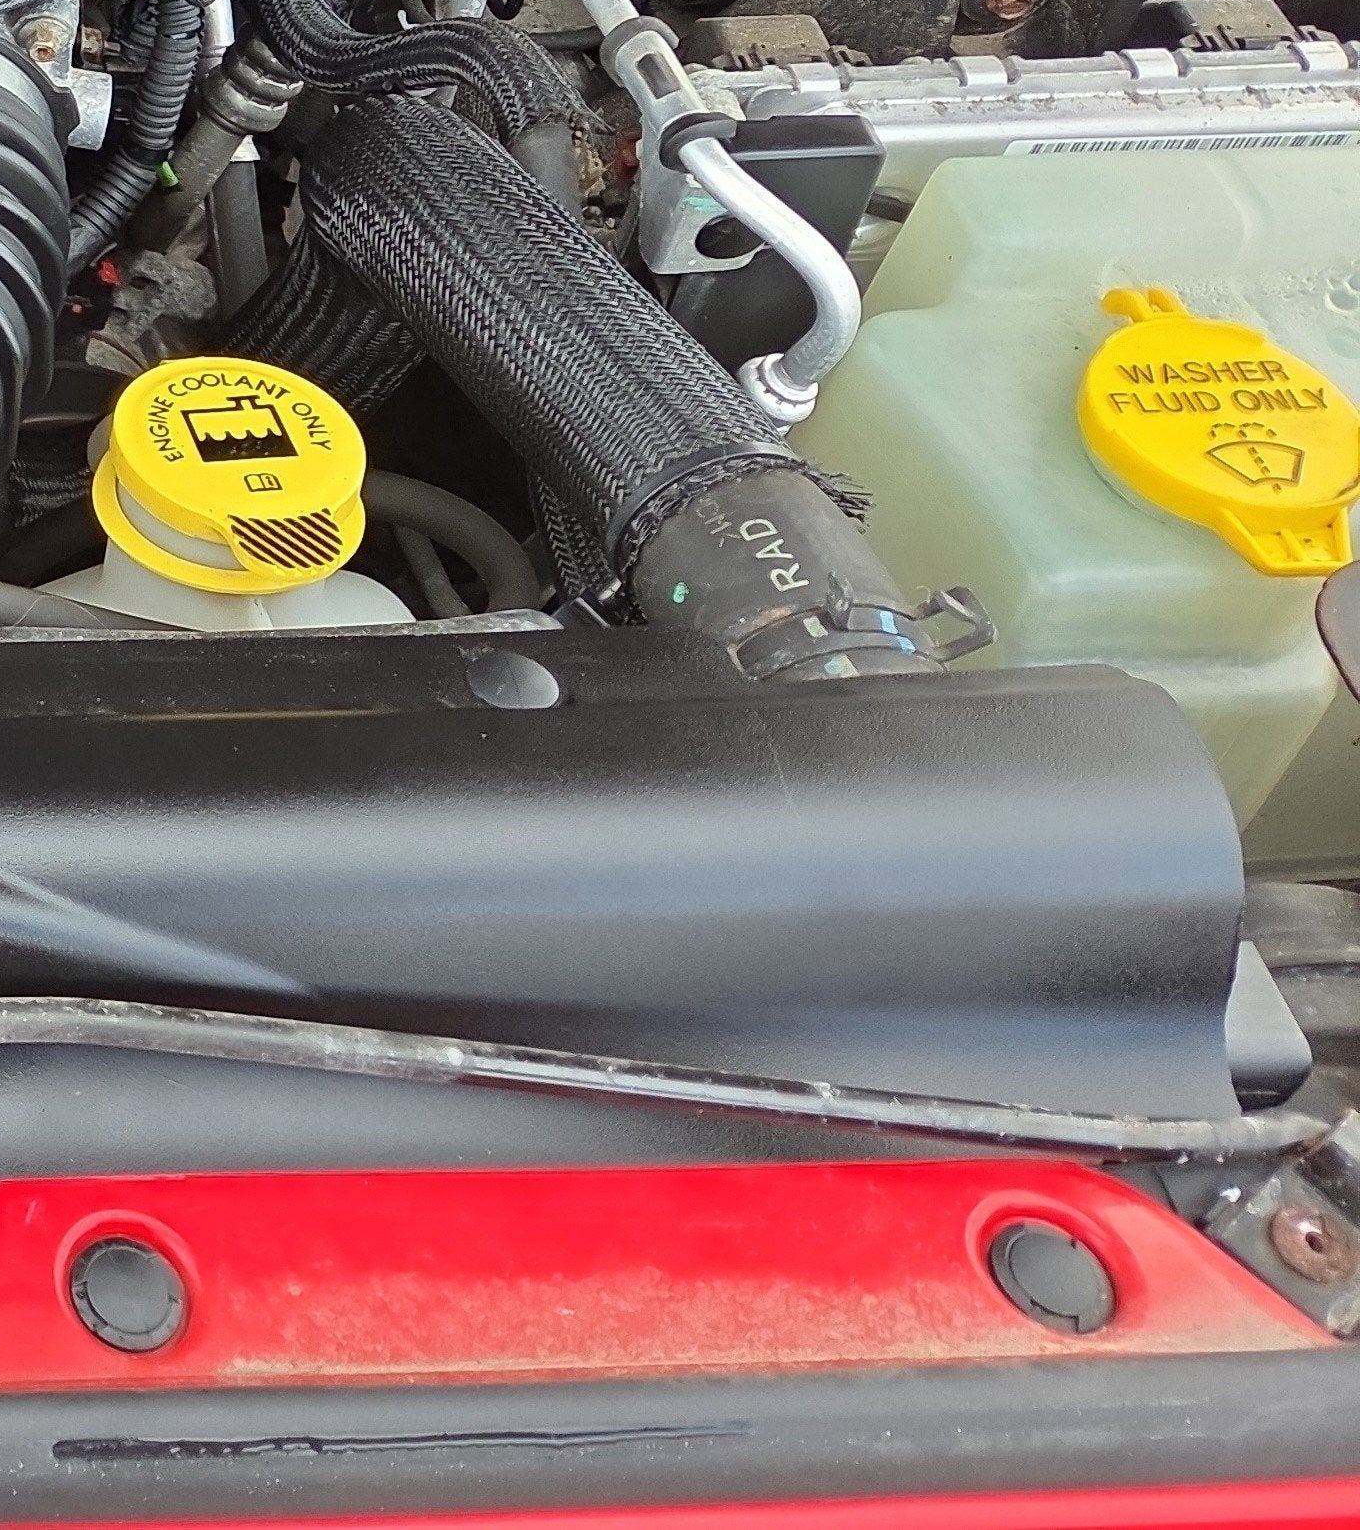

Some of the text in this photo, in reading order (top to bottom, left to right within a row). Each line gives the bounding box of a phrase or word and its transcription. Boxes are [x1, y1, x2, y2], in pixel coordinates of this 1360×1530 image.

[1117, 359, 1291, 385] WASHER
[148, 373, 332, 463] ENGINE COOLANT ONLY
[1108, 387, 1329, 415] FLUID ONLY
[739, 517, 810, 594] RAD
